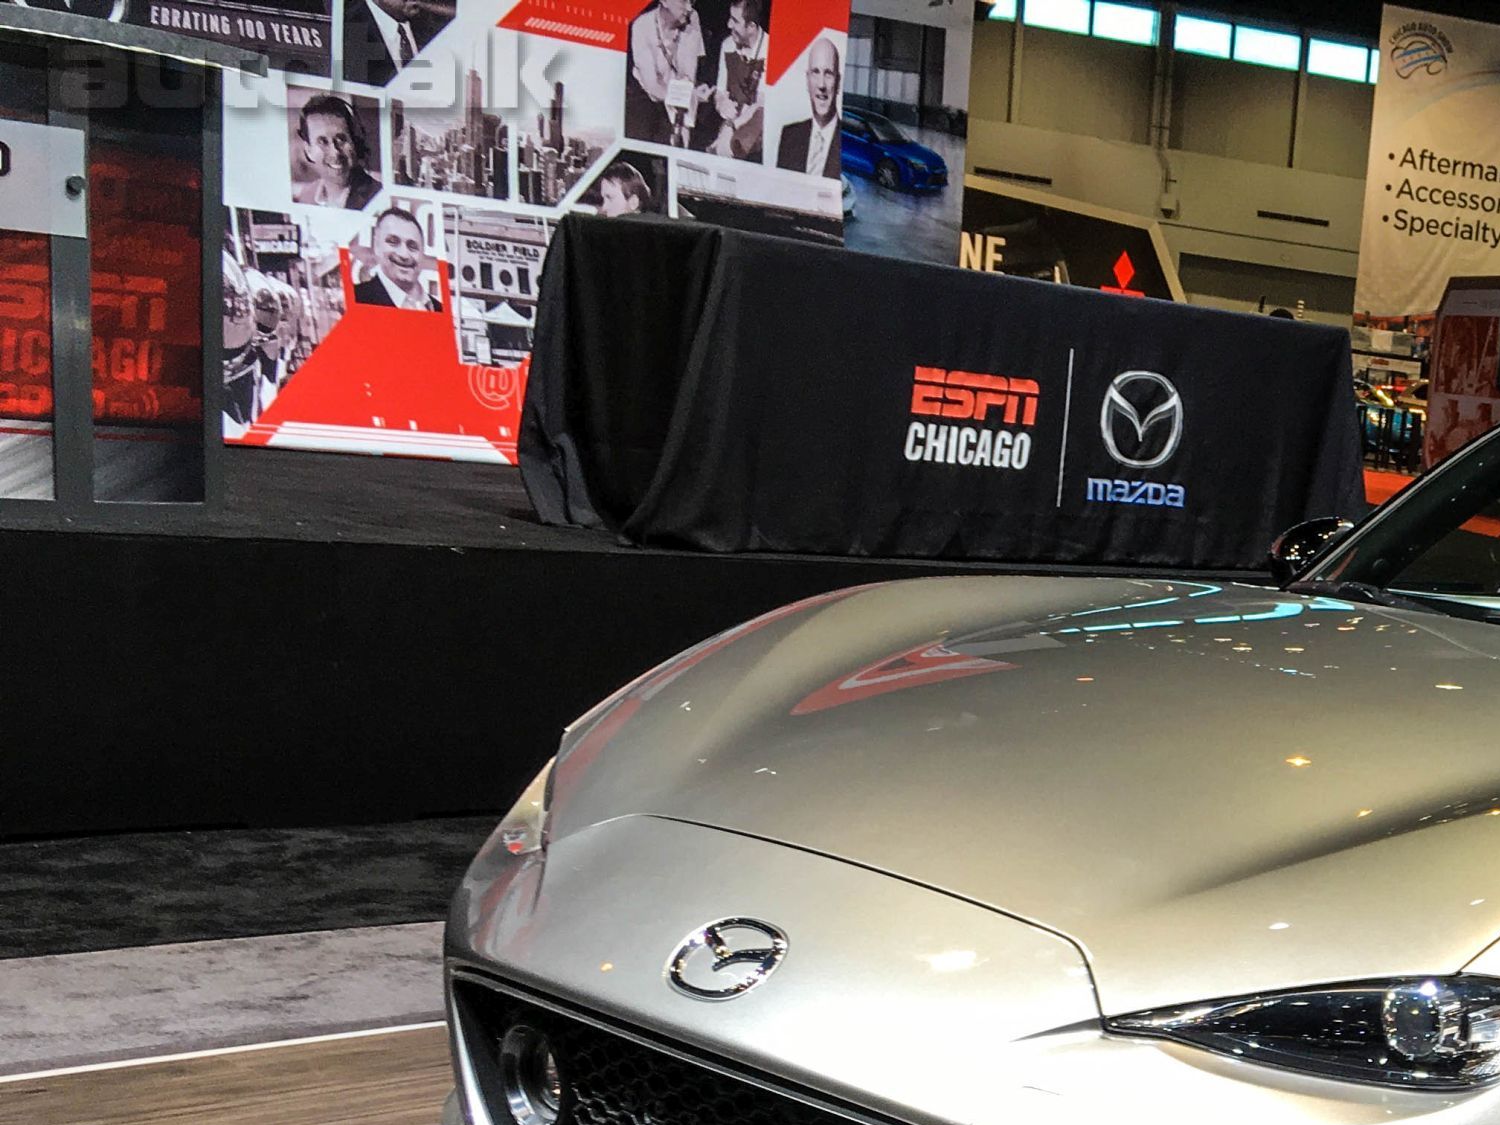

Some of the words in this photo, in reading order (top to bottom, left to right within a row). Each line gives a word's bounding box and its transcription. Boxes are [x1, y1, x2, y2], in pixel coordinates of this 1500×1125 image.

[236, 18, 267, 41] 100
[270, 22, 323, 48] YEARS
[910, 365, 1041, 426] ESPN
[903, 421, 1033, 470] CHICAGO
